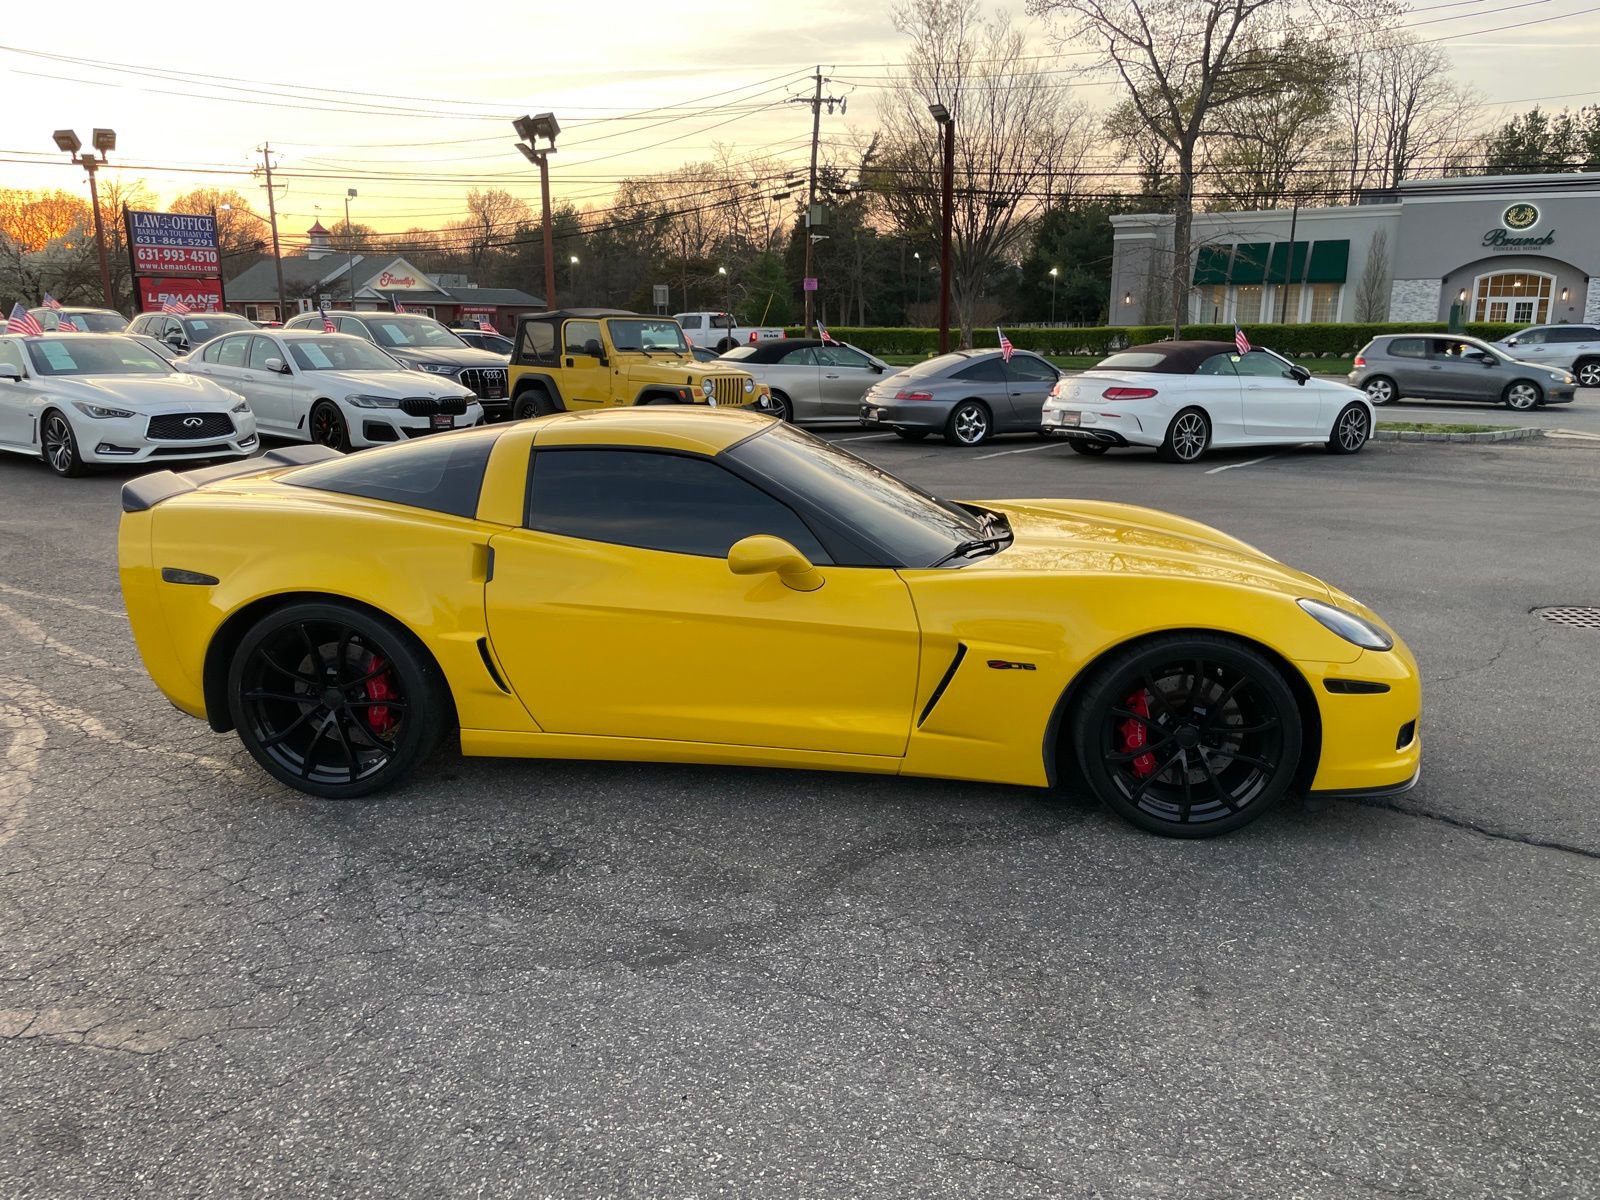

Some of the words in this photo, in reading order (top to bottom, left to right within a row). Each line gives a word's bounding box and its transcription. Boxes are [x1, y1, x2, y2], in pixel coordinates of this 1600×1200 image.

[134, 213, 160, 228] LAW
[171, 216, 213, 232] OFFICE
[137, 228, 168, 237] BARBARA
[169, 229, 202, 239] TOUHAMY
[203, 231, 212, 239] PC
[1482, 228, 1555, 247] Branch
[136, 235, 214, 247] 631-864-5291
[138, 248, 217, 263] 631-993-4510
[139, 262, 218, 272] www.LemansCars.com
